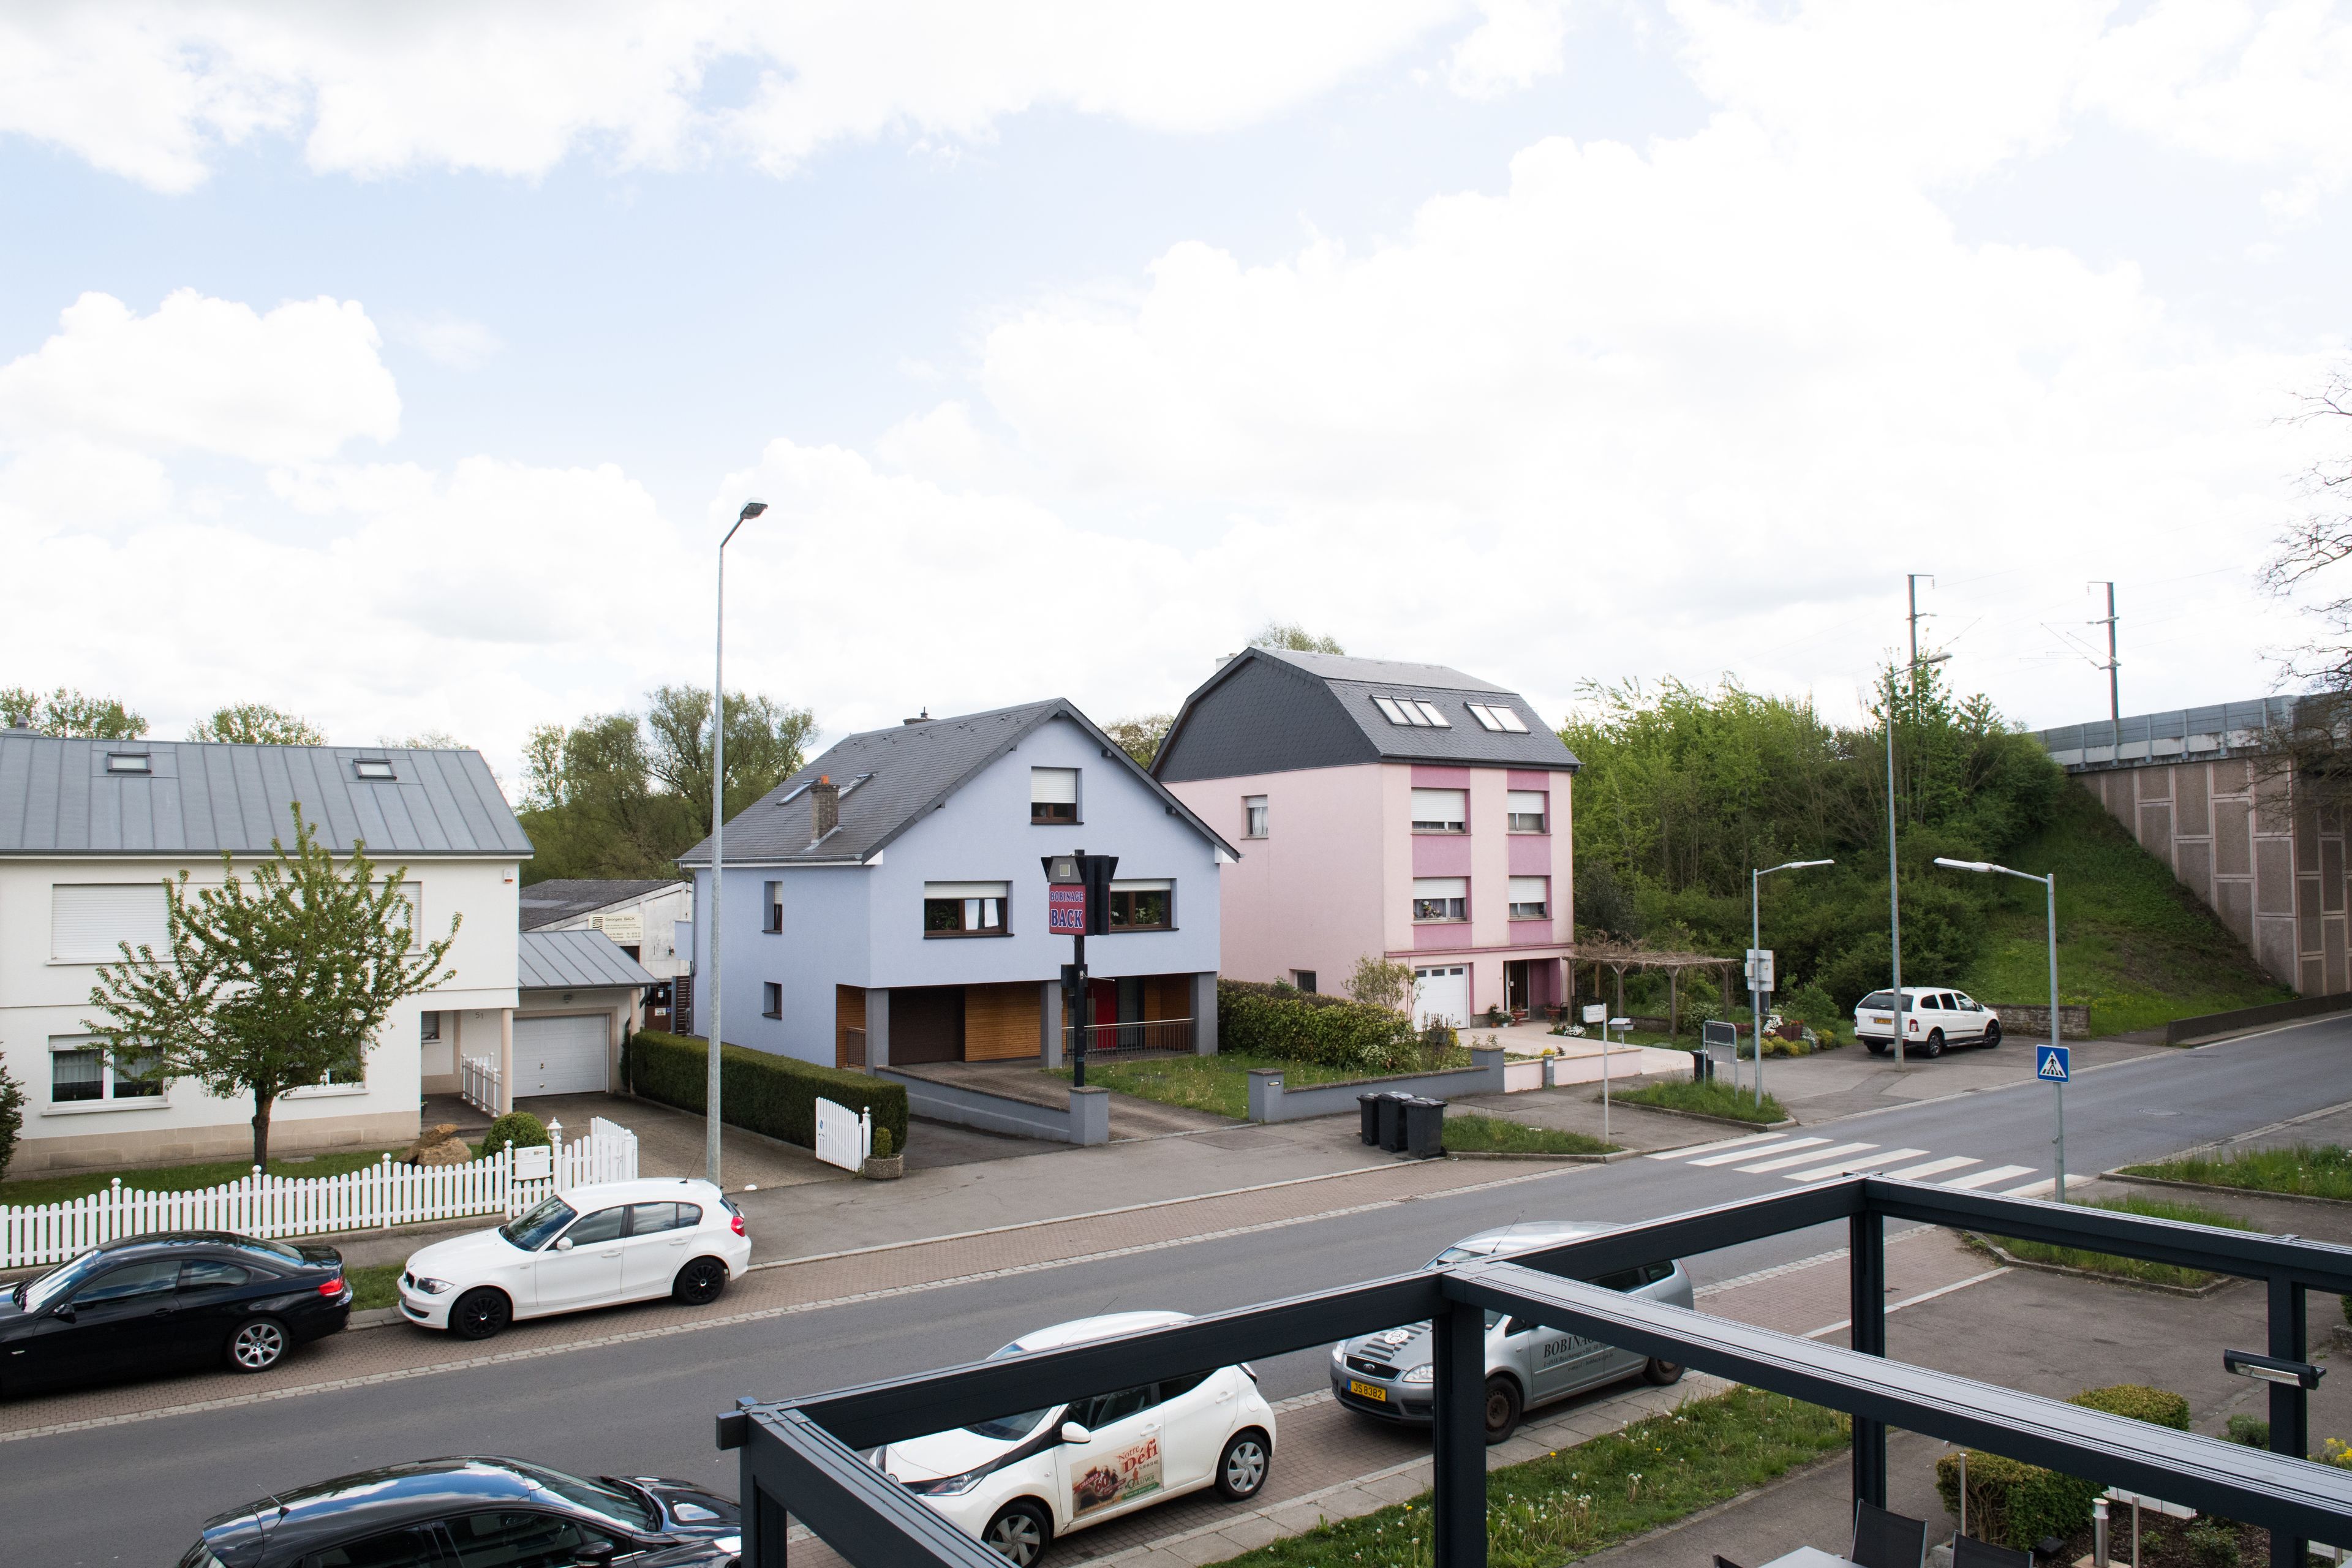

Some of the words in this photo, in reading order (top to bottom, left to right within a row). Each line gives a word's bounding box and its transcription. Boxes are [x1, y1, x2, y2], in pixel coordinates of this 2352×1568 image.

[1050, 891, 1083, 902] BOBINAGE
[1050, 908, 1083, 928] BACK
[1354, 1383, 1363, 1393] JS
[1117, 1446, 1139, 1462] Notre
[1123, 1439, 1158, 1474] Défi
[1095, 1475, 1109, 1493] 60
